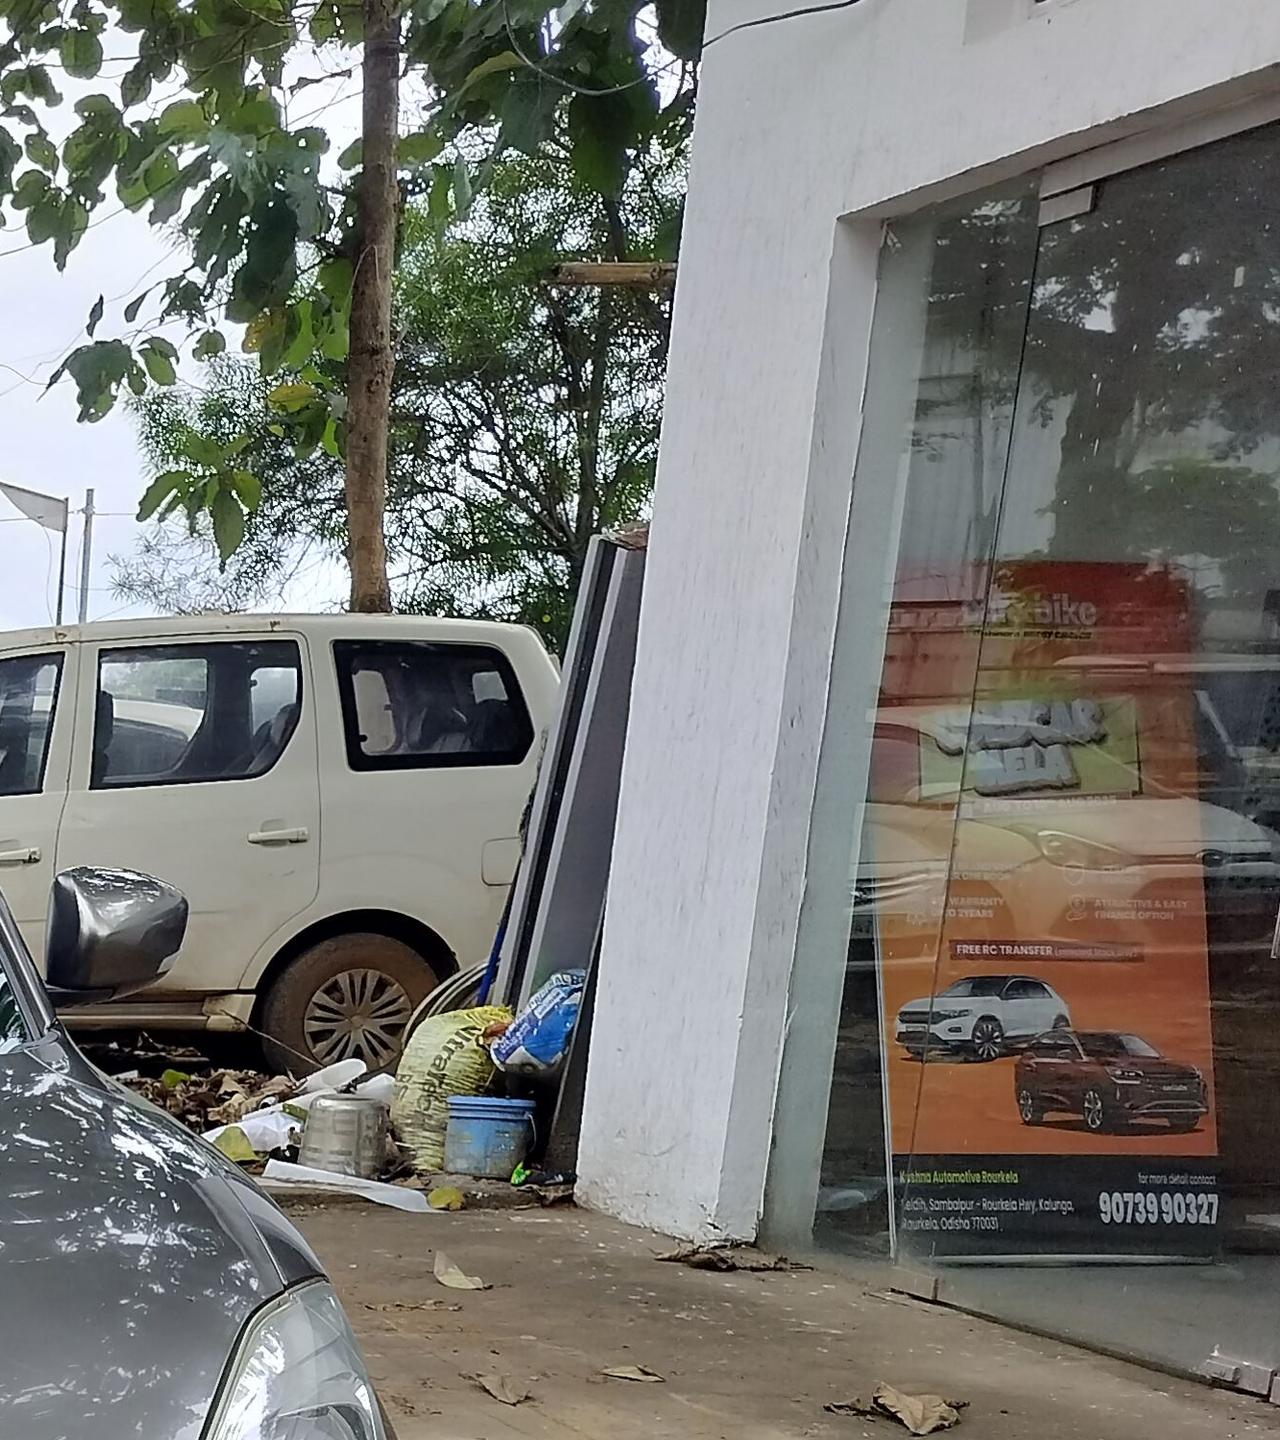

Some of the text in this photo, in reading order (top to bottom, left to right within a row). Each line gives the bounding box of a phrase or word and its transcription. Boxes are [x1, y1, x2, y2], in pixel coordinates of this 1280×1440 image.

[956, 944, 981, 954] FREE
[983, 945, 998, 955] RC
[1000, 945, 1053, 956] TRANSFER
[1099, 1191, 1219, 1226] 90739 90327
